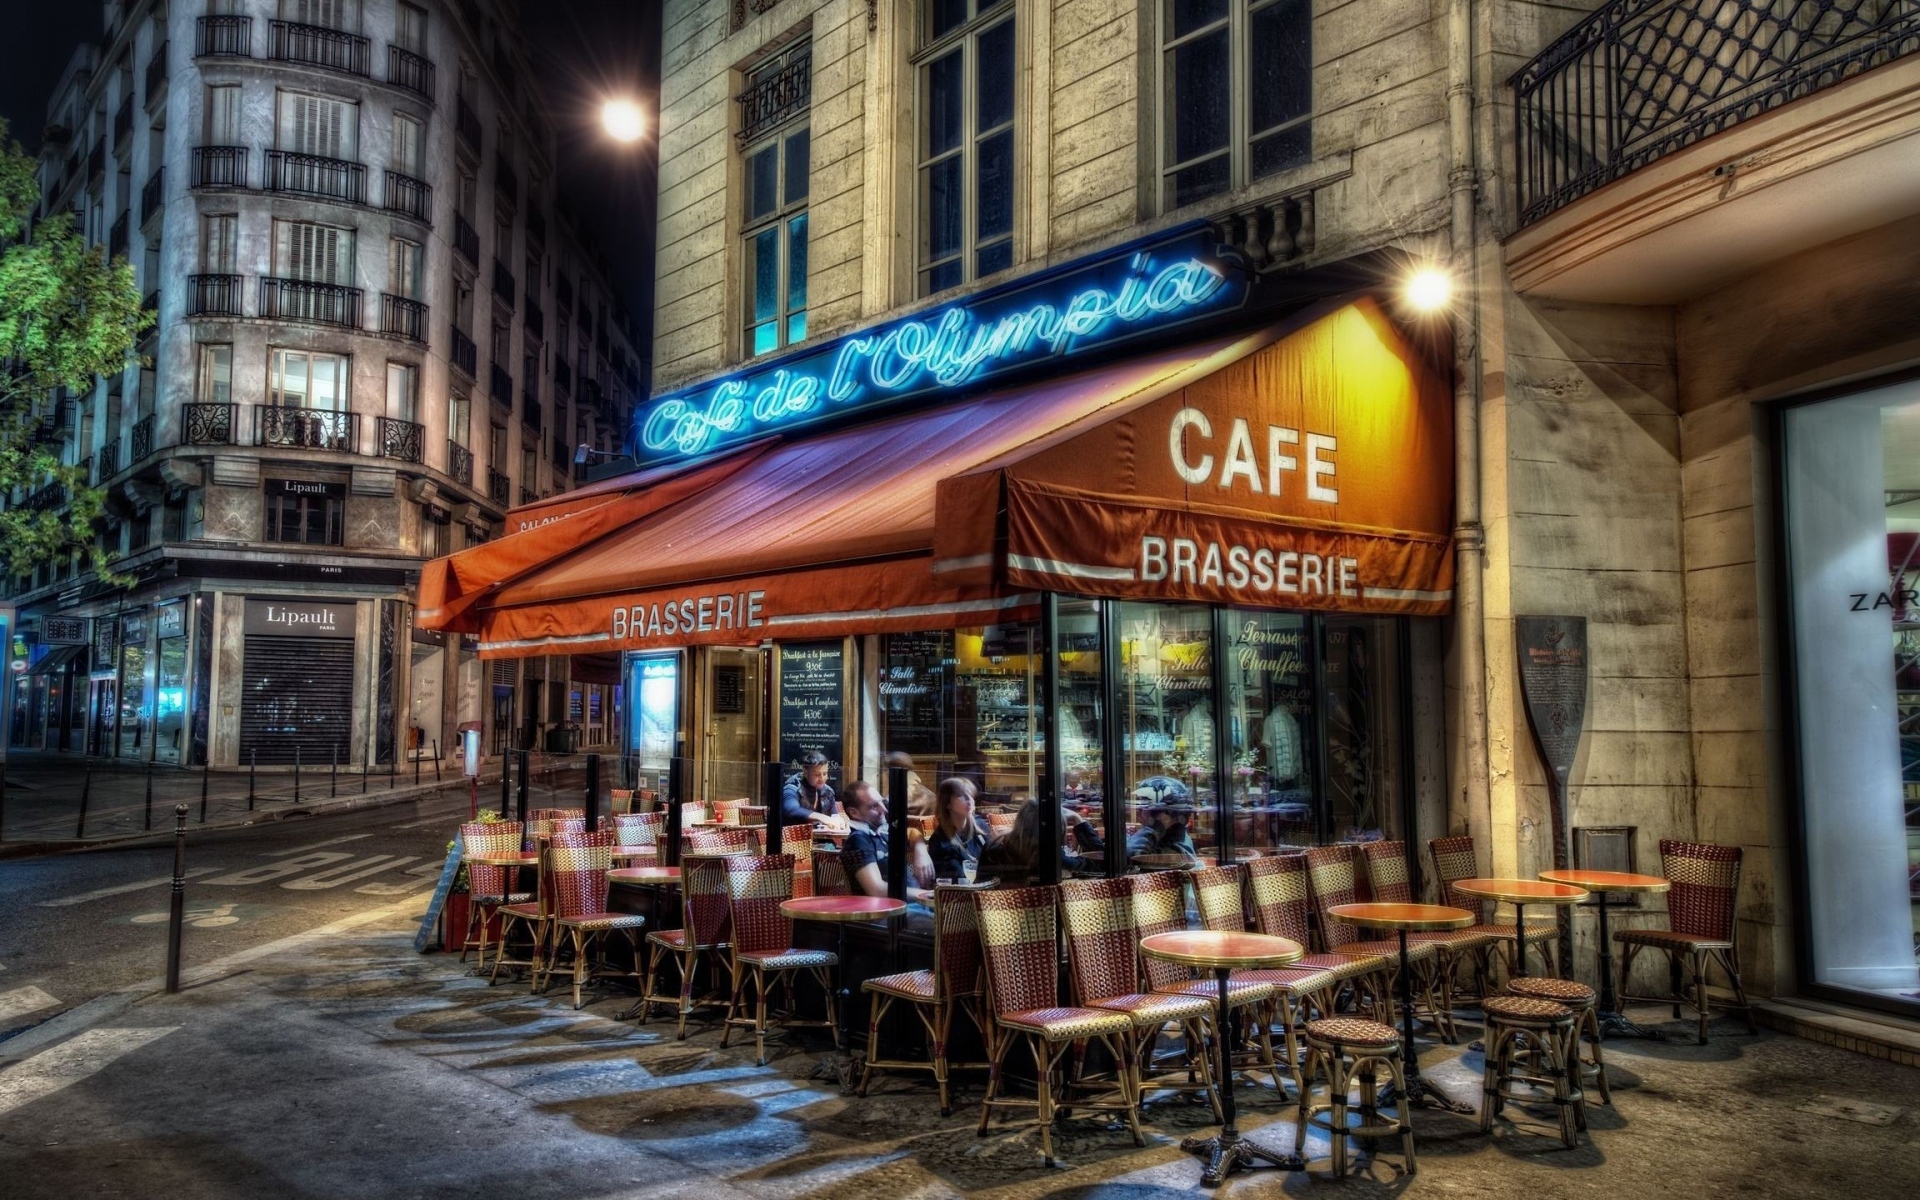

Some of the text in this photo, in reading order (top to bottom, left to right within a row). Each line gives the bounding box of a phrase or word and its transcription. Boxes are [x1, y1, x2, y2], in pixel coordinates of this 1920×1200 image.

[753, 370, 819, 423] de
[1170, 408, 1338, 503] CAFE
[285, 480, 326, 494] Lipault
[1141, 535, 1358, 598] BRASSERIE
[266, 607, 335, 626] Lipault
[613, 592, 765, 639] BRASSERIE
[890, 666, 915, 679] Salle
[1171, 656, 1208, 671] Salle
[879, 682, 928, 695] Climatisée
